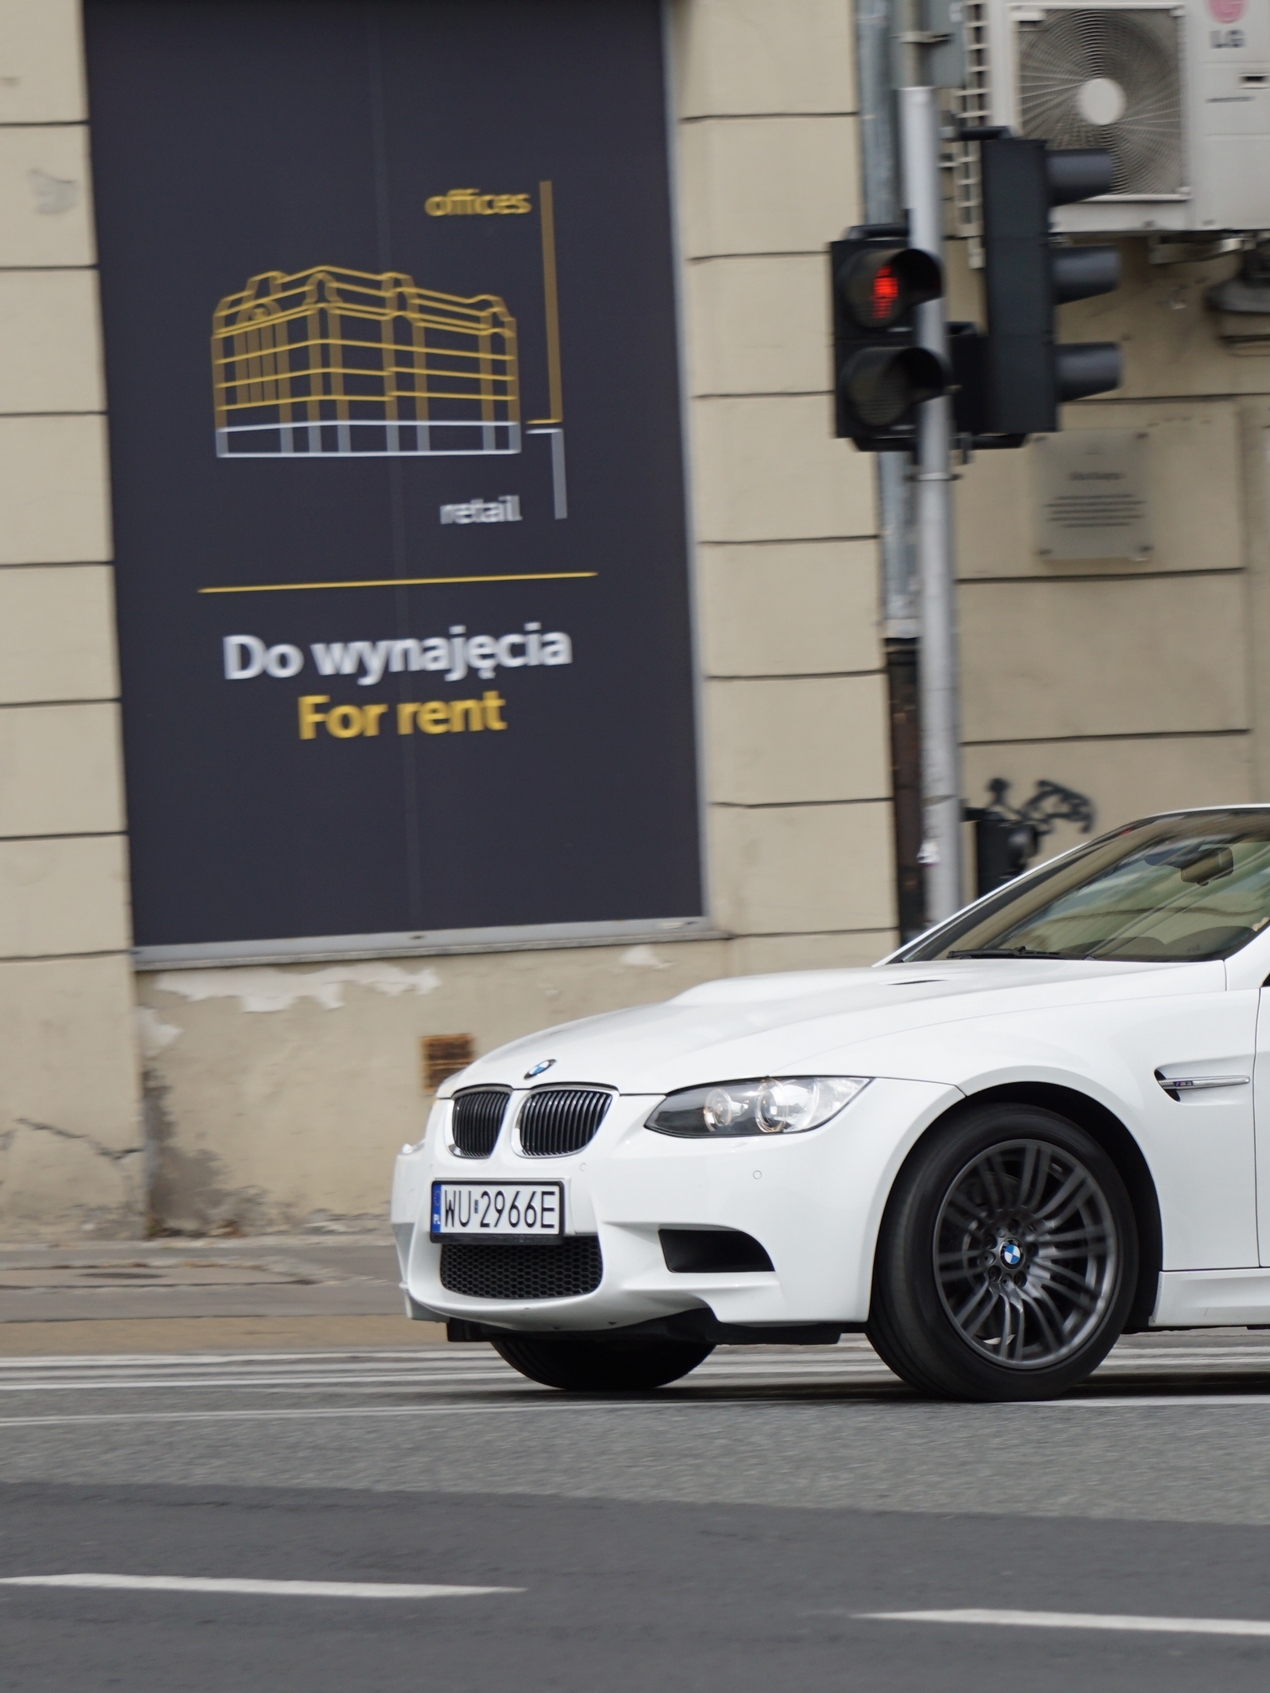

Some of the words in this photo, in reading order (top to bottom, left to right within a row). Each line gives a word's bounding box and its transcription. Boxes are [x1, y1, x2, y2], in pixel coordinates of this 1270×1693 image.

[1210, 30, 1245, 49] LG
[424, 188, 532, 216] offices
[440, 495, 523, 525] retail
[223, 634, 304, 680] Do
[310, 622, 573, 686] wynajęcia
[298, 695, 388, 740] For
[397, 690, 507, 736] rent
[444, 1189, 472, 1228] WU
[480, 1189, 556, 1228] 2966E
